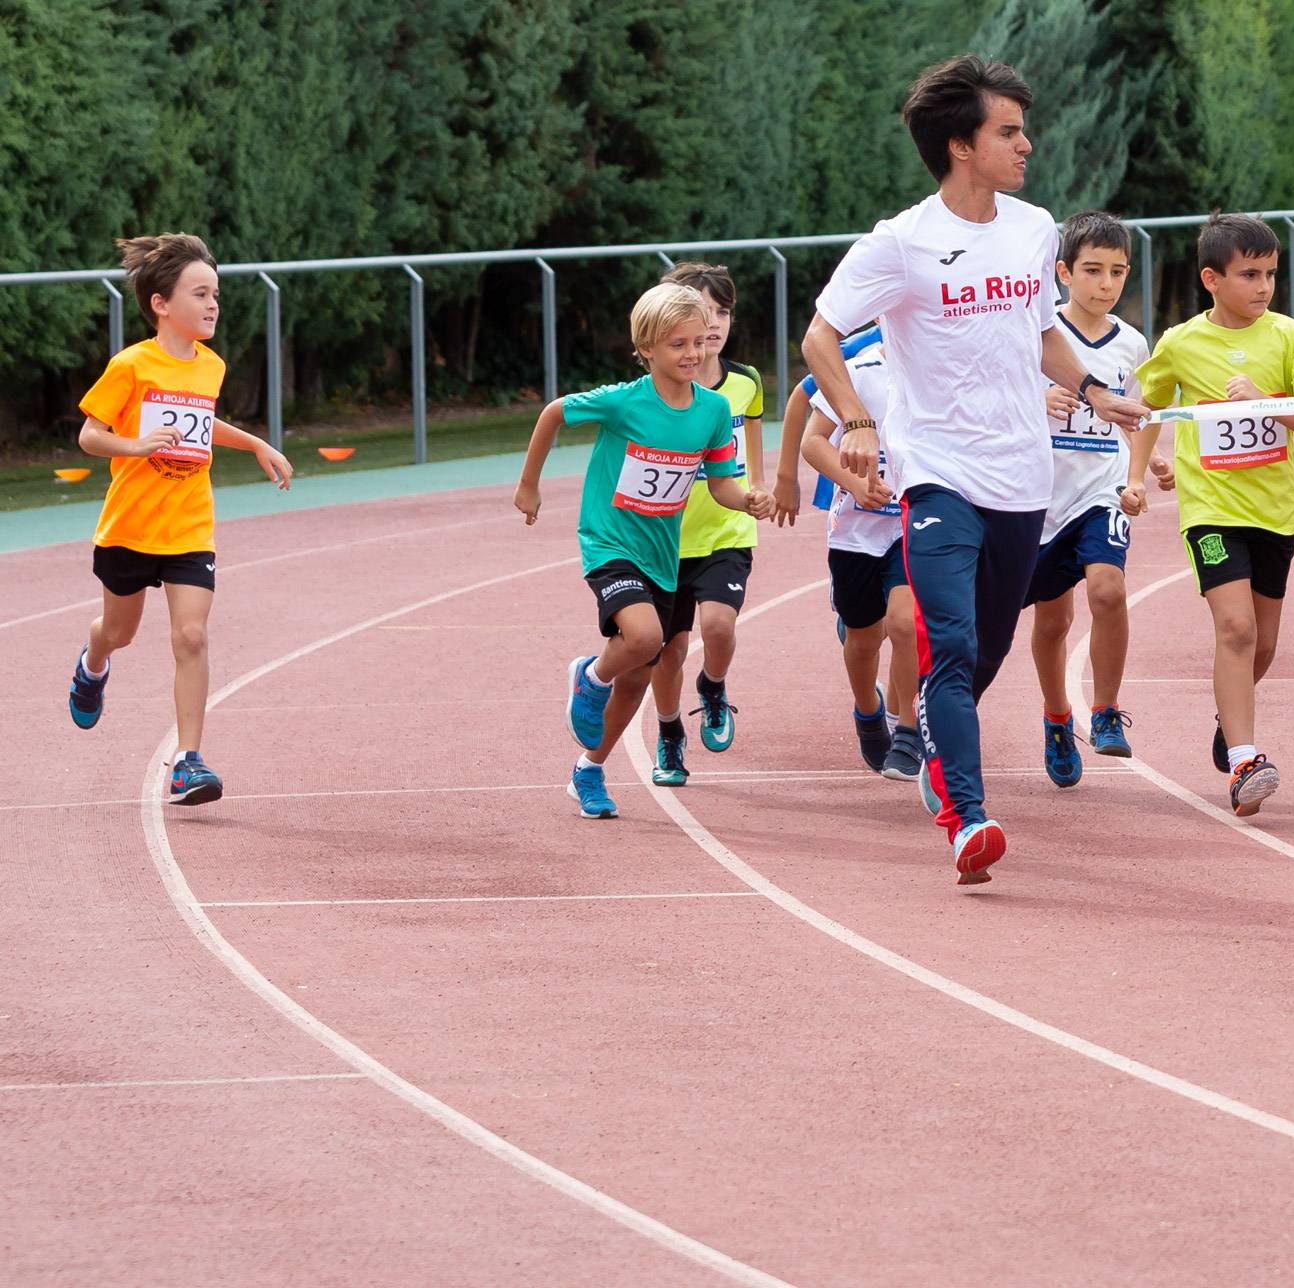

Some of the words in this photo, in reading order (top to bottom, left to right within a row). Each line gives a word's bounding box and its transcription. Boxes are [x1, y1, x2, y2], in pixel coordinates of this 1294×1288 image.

[941, 283, 976, 305] La
[985, 274, 1041, 309] Rioja
[943, 303, 1012, 318] atletismo
[151, 393, 161, 401] LA
[163, 395, 185, 404] RIOJA
[162, 410, 212, 446] 328
[1217, 416, 1277, 451] 338
[634, 450, 645, 459] LA
[647, 453, 670, 463] RIOJA
[1107, 508, 1131, 543] 10
